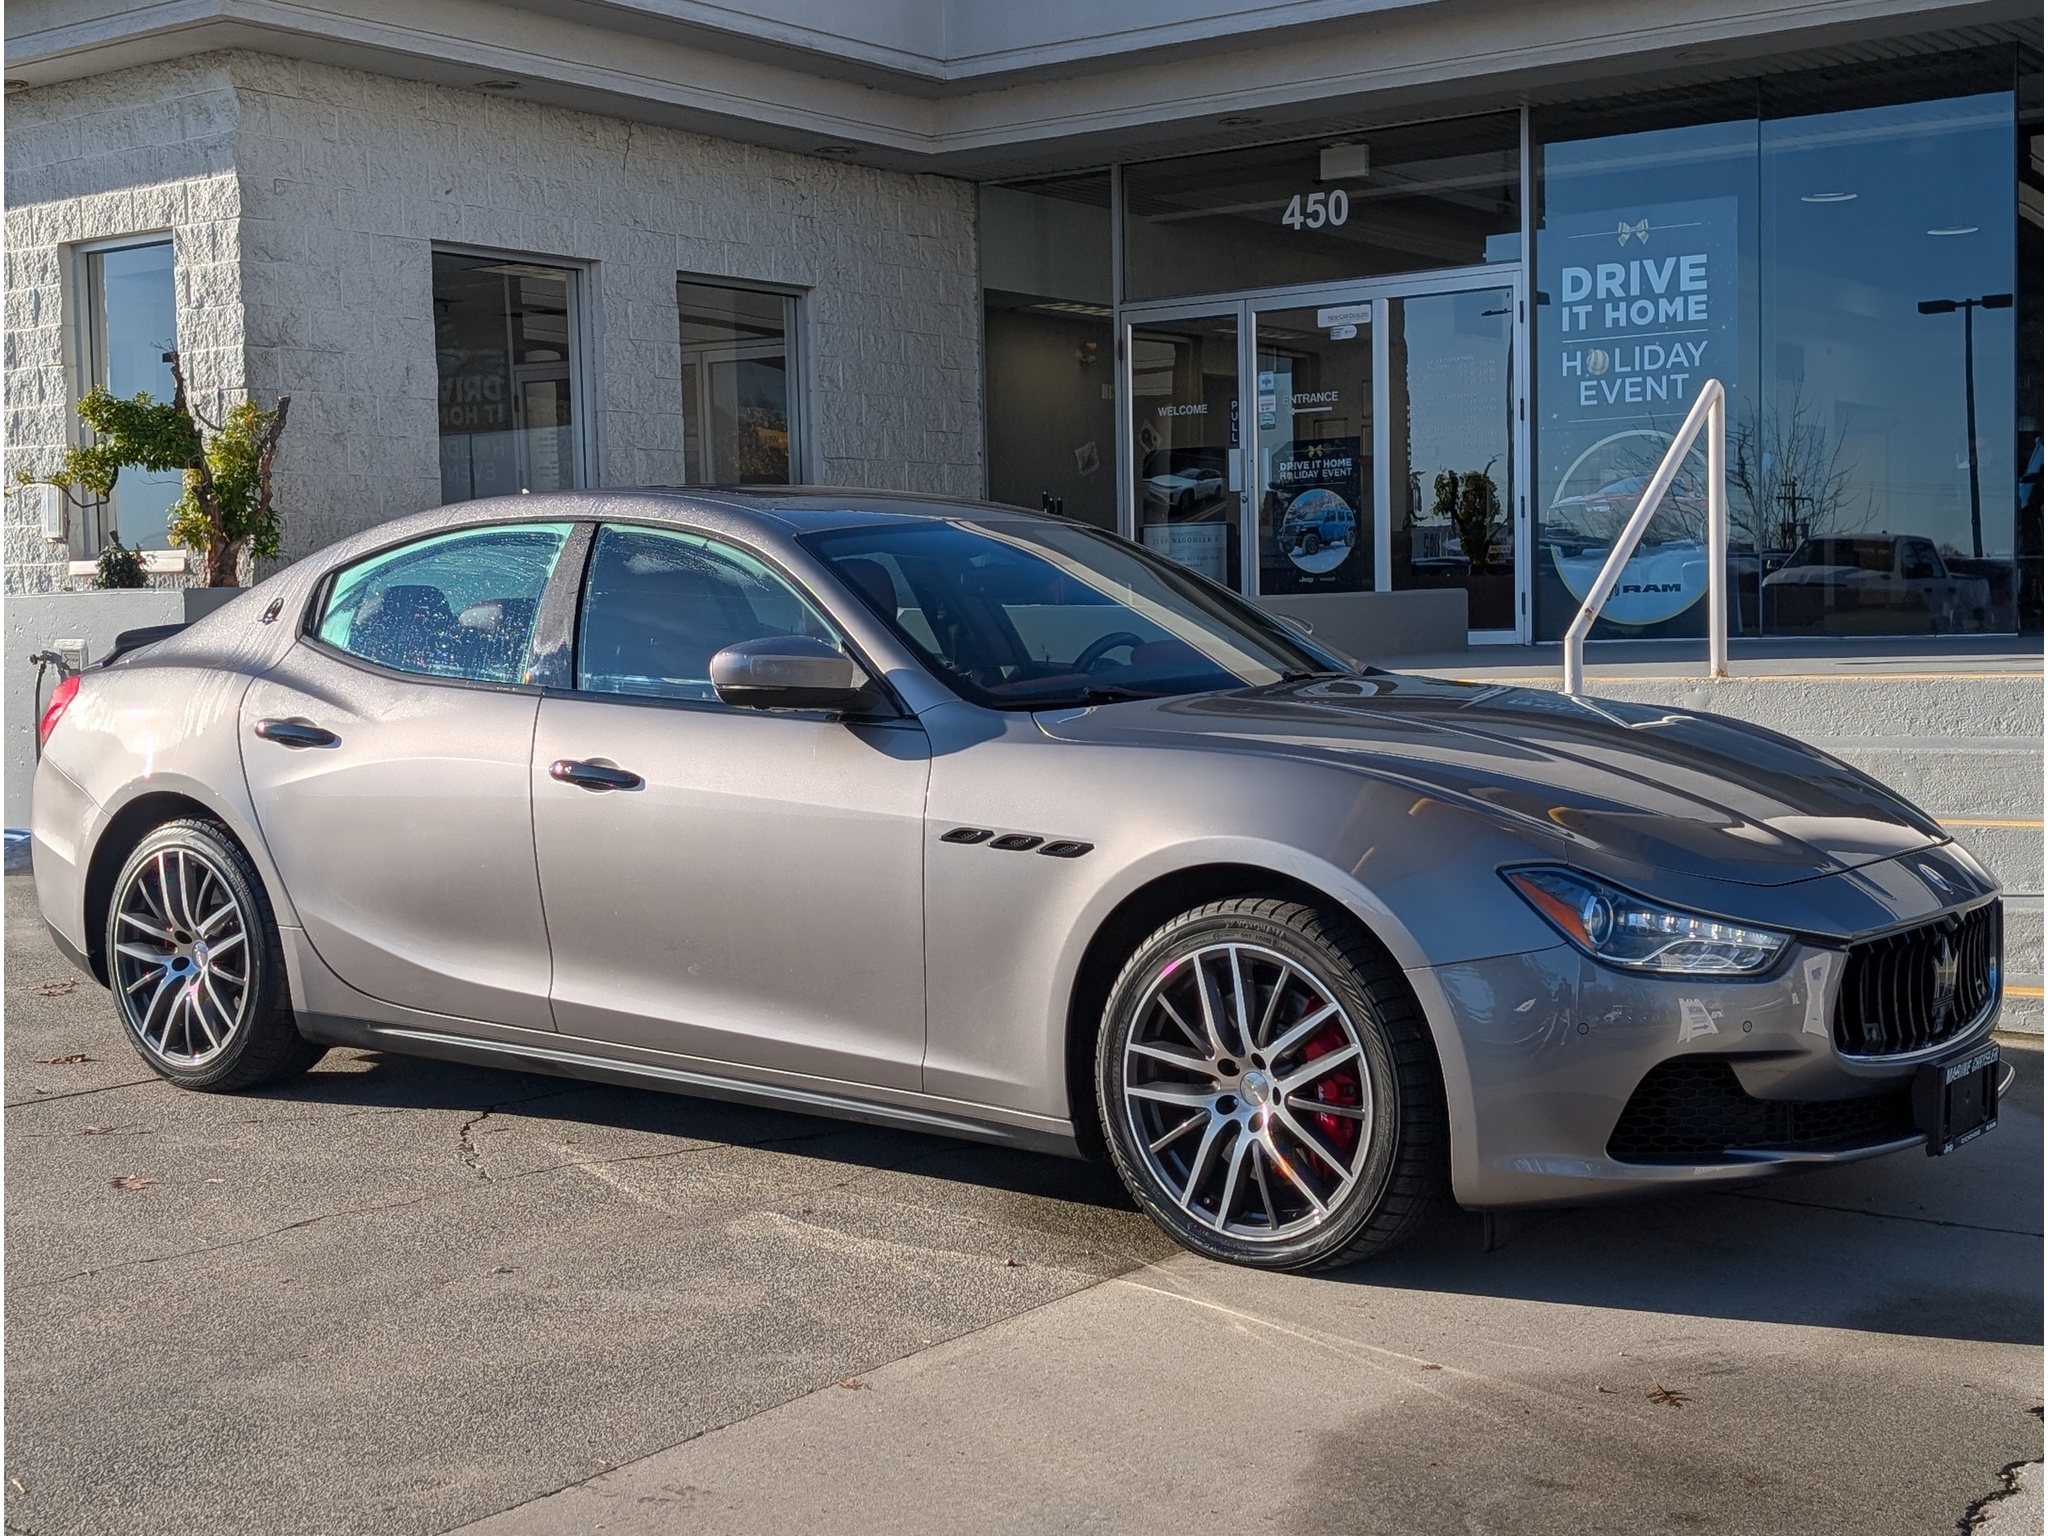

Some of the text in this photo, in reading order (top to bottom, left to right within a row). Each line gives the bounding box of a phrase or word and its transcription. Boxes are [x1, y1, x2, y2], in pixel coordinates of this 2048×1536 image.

[1282, 189, 1348, 230] 450
[1562, 254, 1708, 302] DRIVE
[1562, 294, 1708, 331] IT HOME
[1562, 341, 1708, 377] HOLIDAY
[1283, 391, 1339, 405] ENTRANCE
[1580, 373, 1690, 406] EVENT
[1158, 404, 1208, 417] WELCOME
[1280, 458, 1352, 471] DRIVE IT HOME
[1280, 468, 1352, 480] HOLIDAY EVENT
[1623, 583, 1681, 594] RAM
